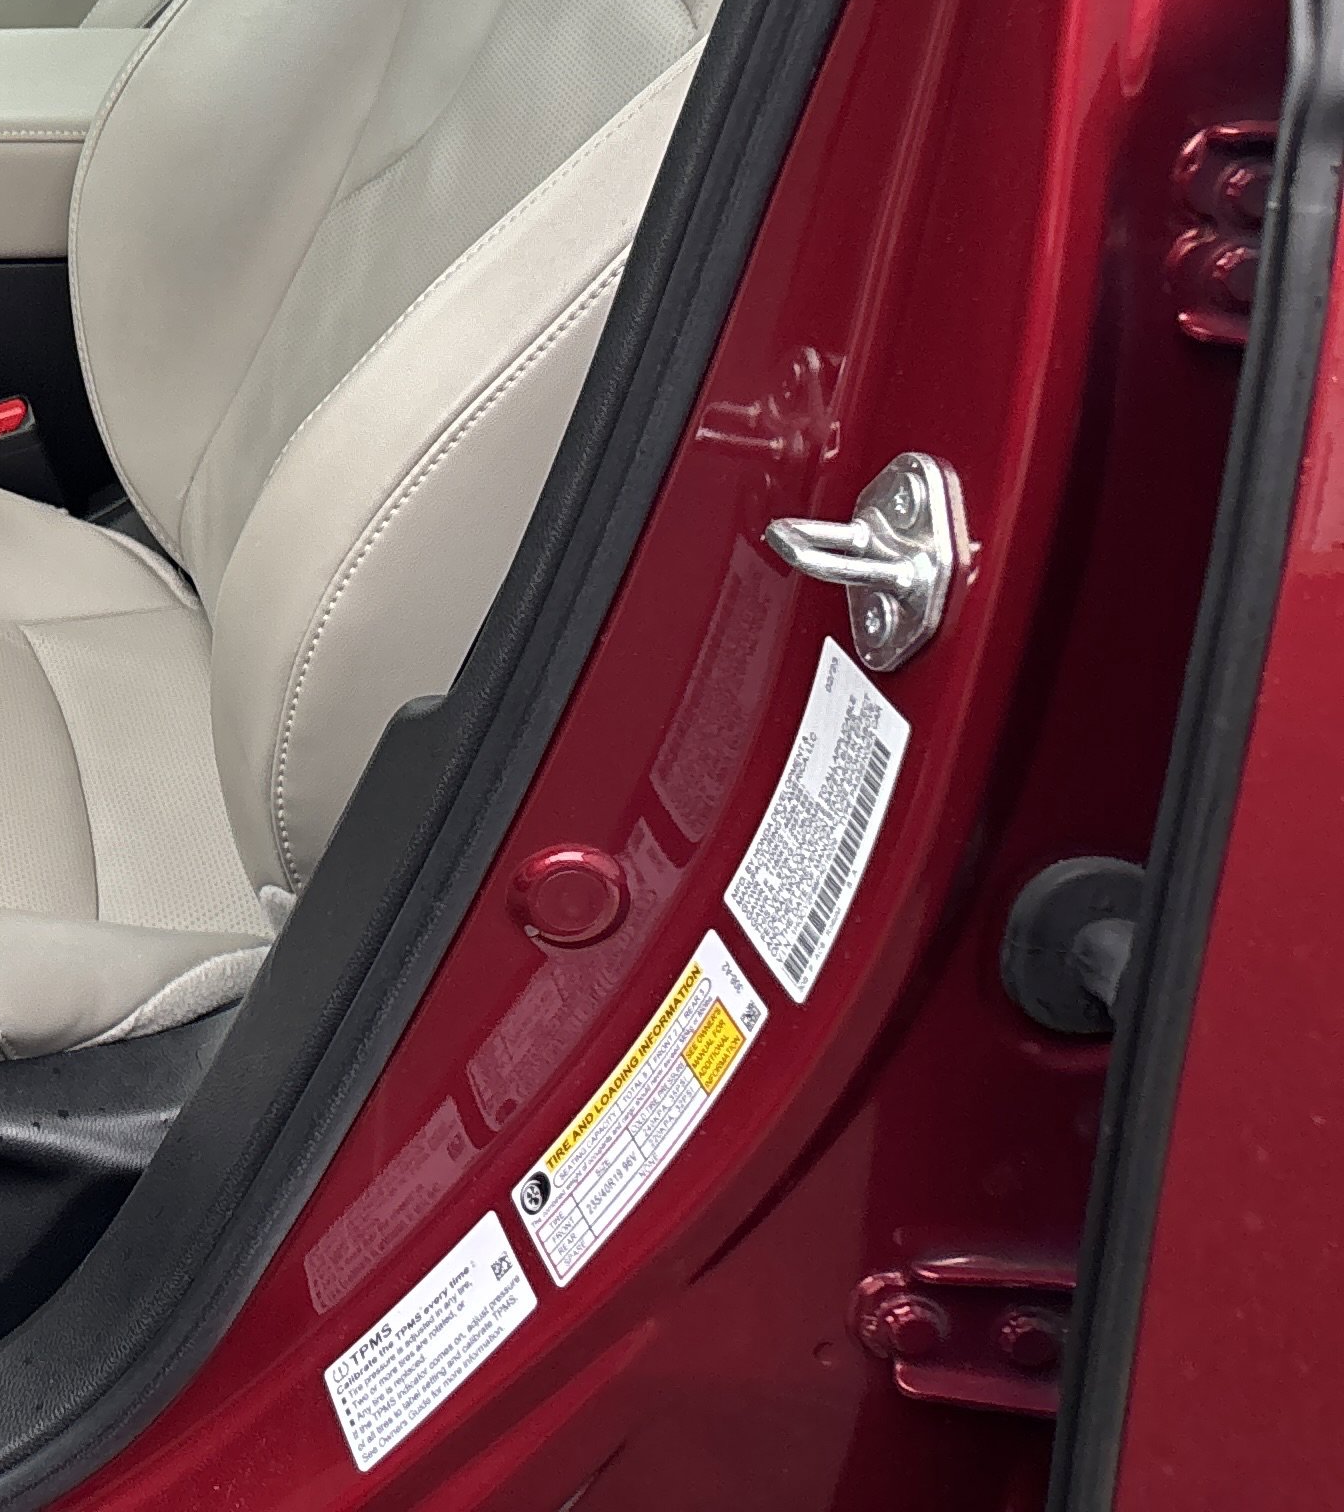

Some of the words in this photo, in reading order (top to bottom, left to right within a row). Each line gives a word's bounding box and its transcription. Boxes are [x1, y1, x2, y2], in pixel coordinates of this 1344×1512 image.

[546, 1138, 571, 1168] TIRE
[572, 1112, 594, 1142] AND
[593, 1055, 639, 1113] LOADING
[638, 965, 700, 1056] INFORMATION
[558, 1147, 587, 1180] SEATING
[586, 1111, 616, 1148] CAPACITY
[336, 1356, 377, 1395] Calibrate
[378, 1340, 394, 1357] the
[395, 1312, 422, 1340] TPMS
[423, 1287, 448, 1314] every
[448, 1266, 469, 1288] time
[351, 1323, 392, 1365] TPMS
